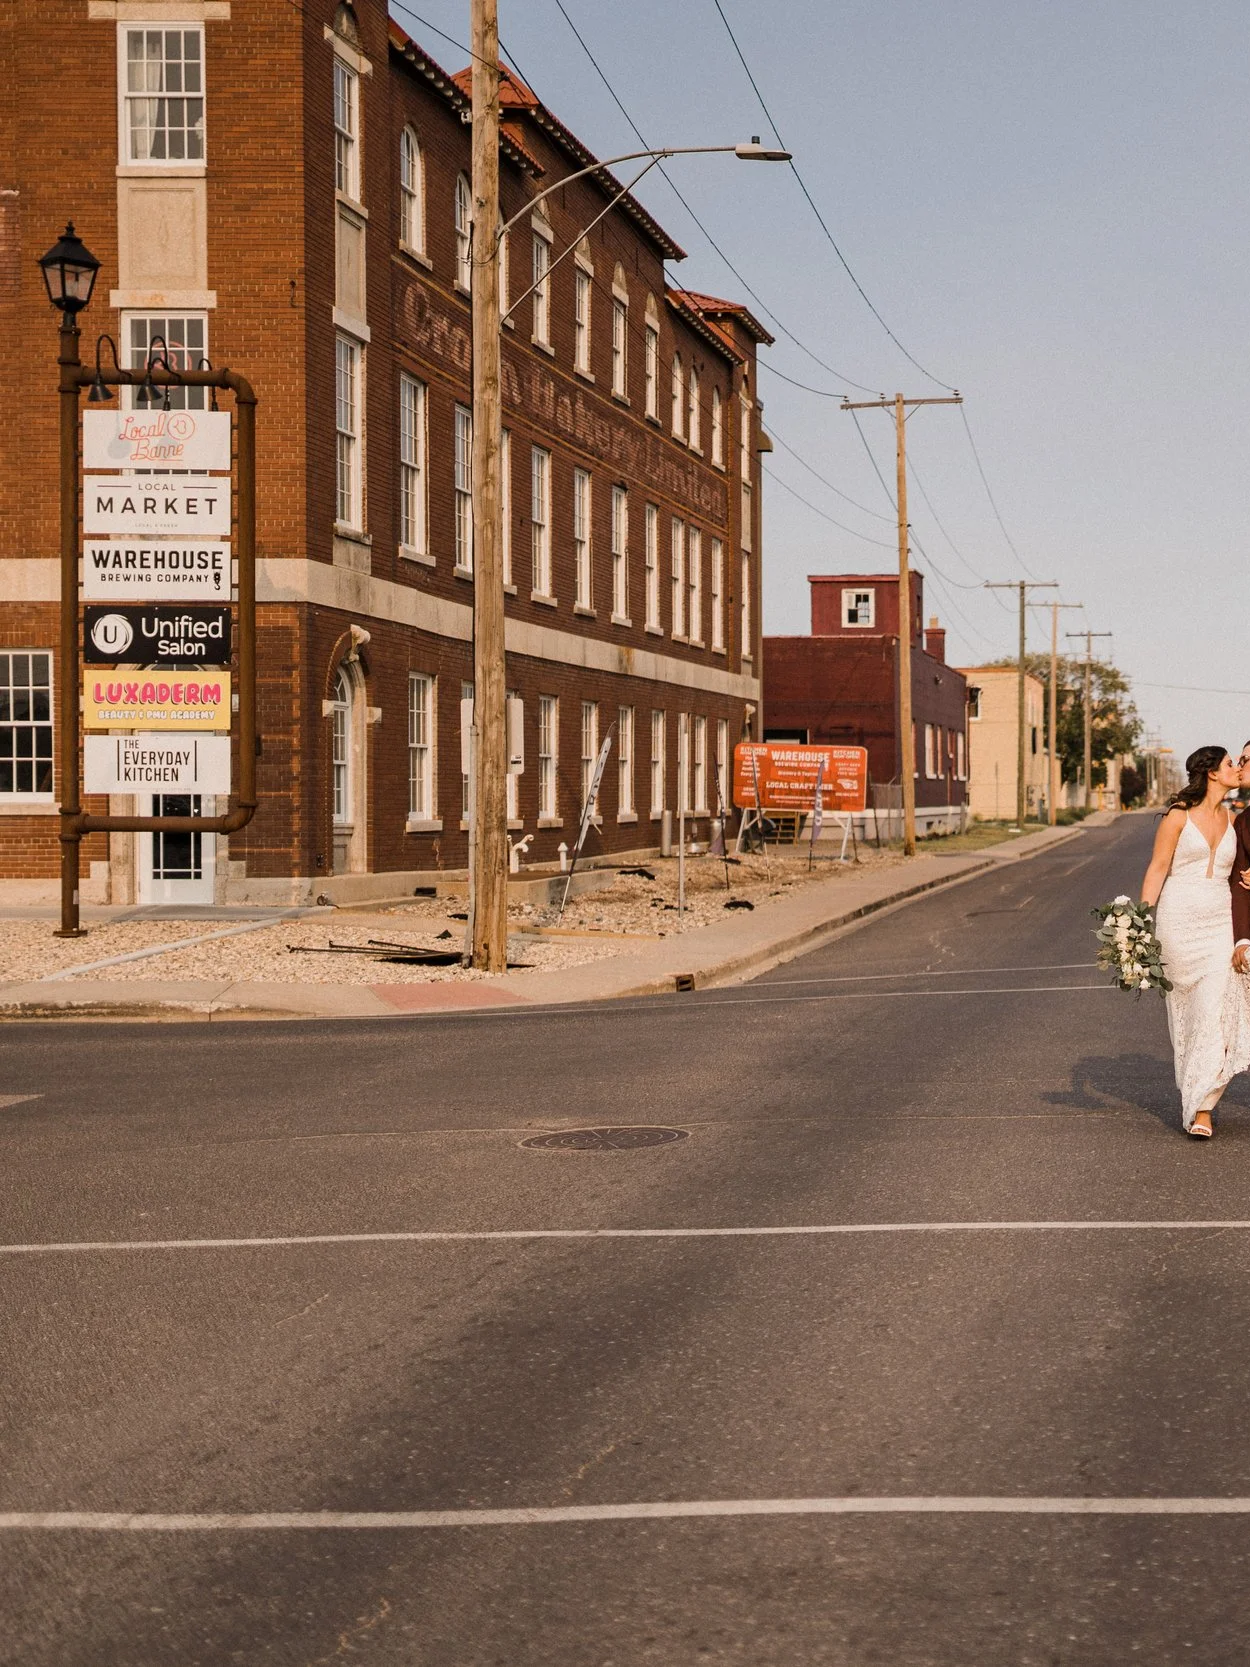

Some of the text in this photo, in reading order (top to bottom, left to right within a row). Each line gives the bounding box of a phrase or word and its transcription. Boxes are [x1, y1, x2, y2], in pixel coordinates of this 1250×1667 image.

[119, 412, 167, 441] Local
[138, 483, 176, 491] LOCAL
[96, 497, 218, 515] MARKET
[91, 549, 224, 570] WAREHOUSE
[101, 574, 209, 583] BREWING COMPANY
[103, 615, 223, 644] U Unified
[158, 640, 206, 656] Salon
[93, 682, 221, 706] LUXADERM
[98, 710, 137, 720] BEAUTY
[146, 711, 168, 720] PMU
[170, 711, 216, 721] ACADEMY
[124, 739, 140, 749] THE
[124, 751, 191, 766] EVERYDAY
[771, 751, 831, 763] WAREHOUSE
[124, 768, 180, 781] KITCHEN
[766, 781, 789, 789] LOCAL
[790, 782, 813, 790] CRAFT
